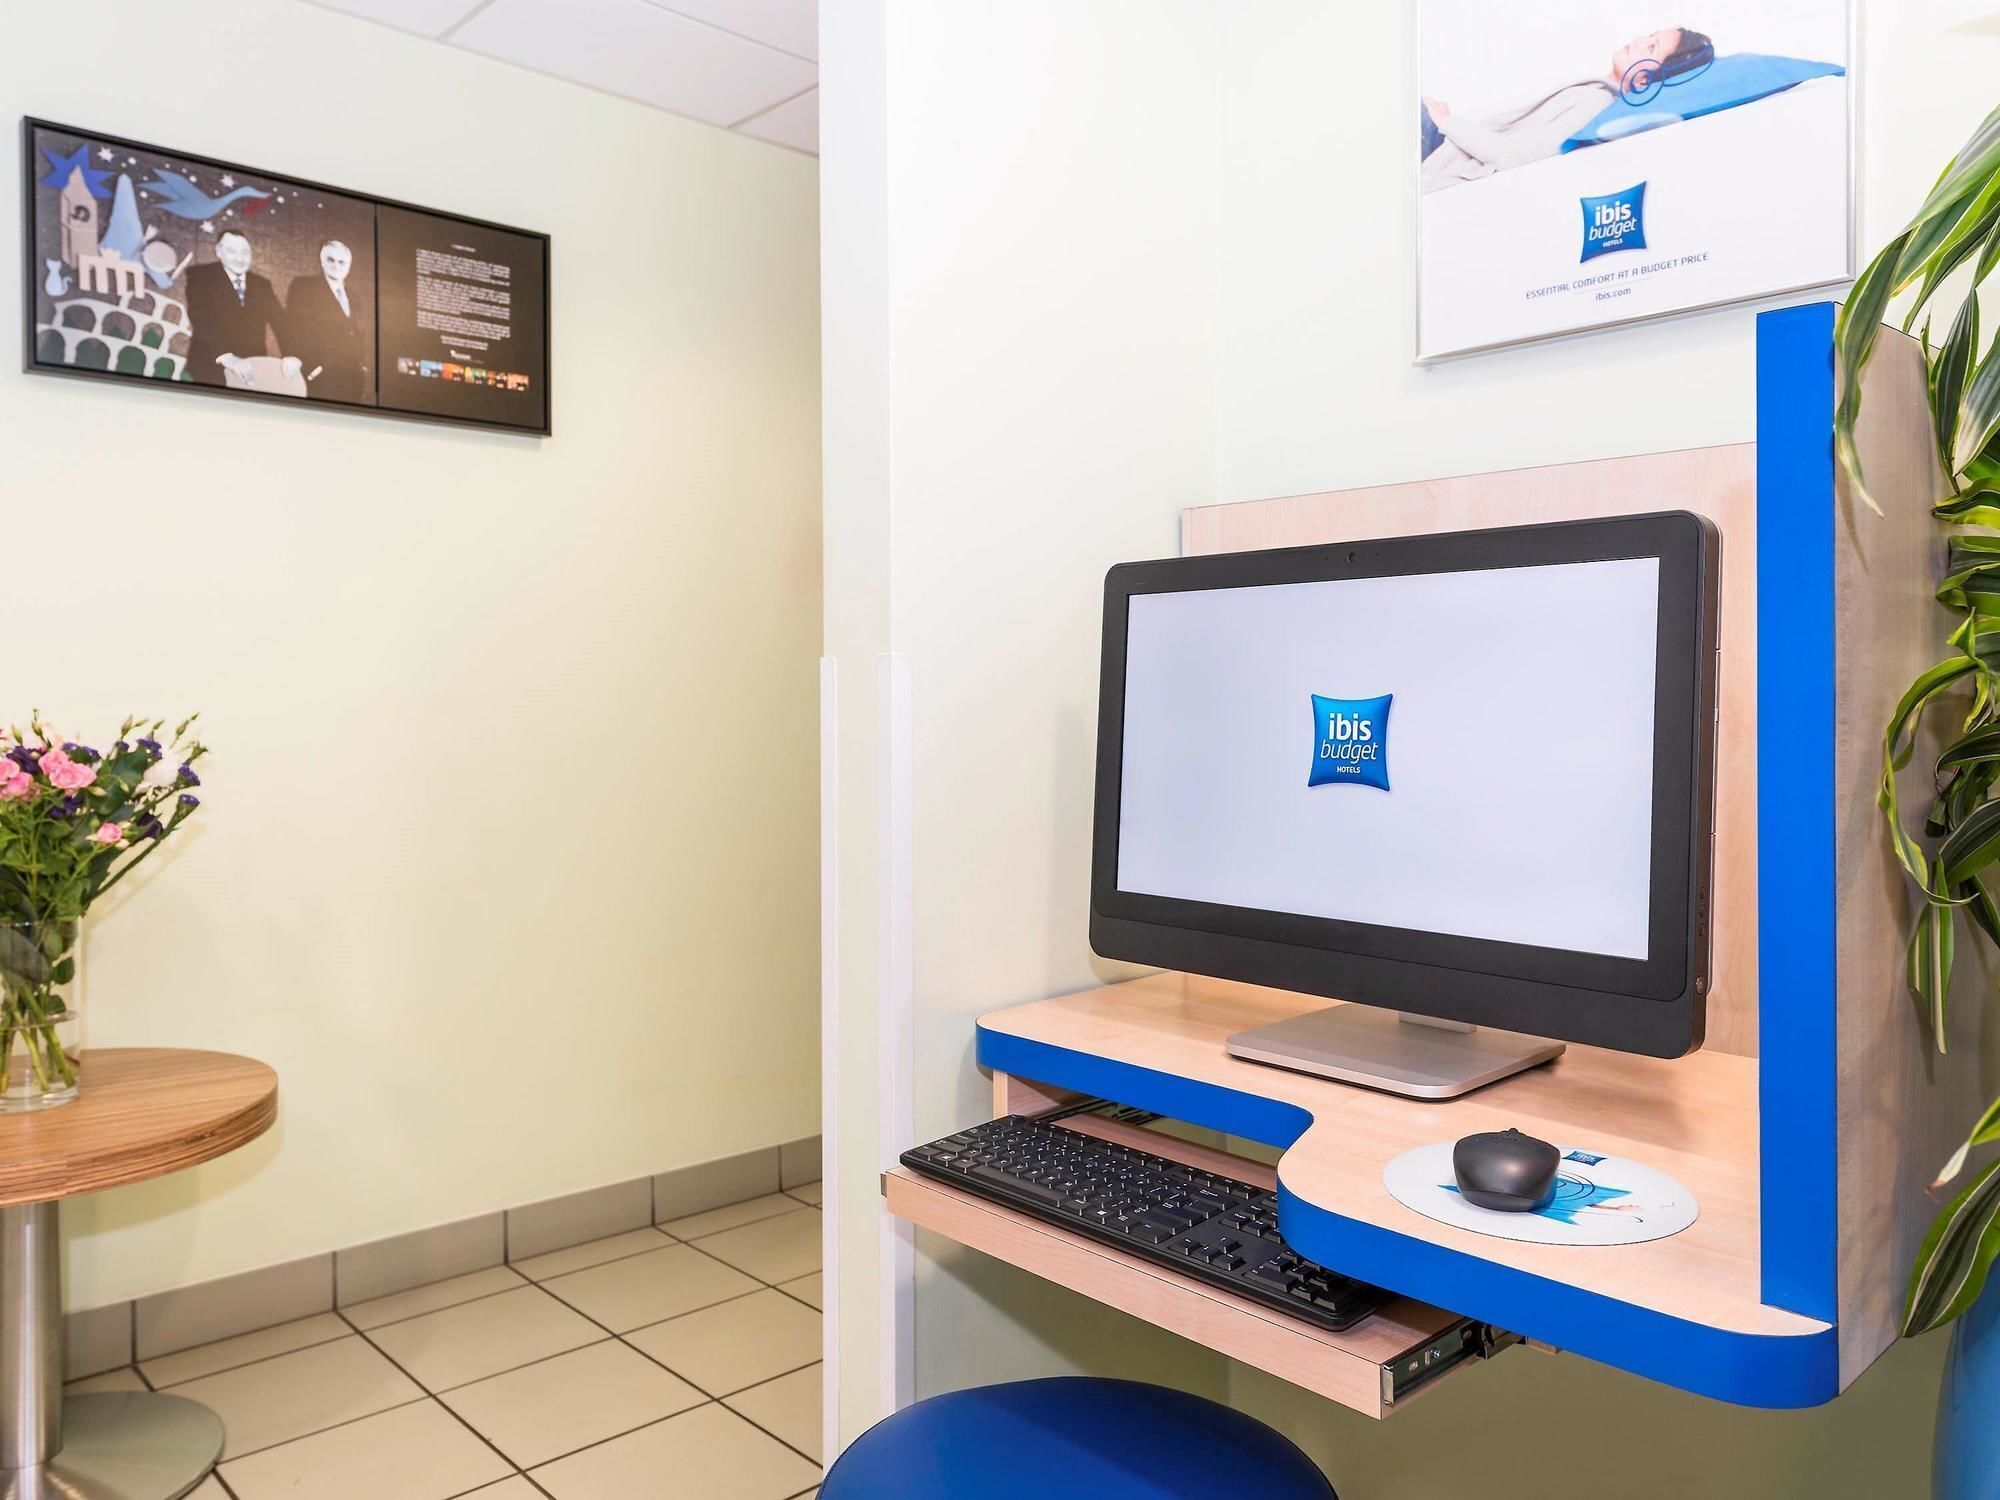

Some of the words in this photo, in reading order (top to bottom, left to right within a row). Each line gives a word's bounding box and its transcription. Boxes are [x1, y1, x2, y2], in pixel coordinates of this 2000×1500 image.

[1595, 201, 1631, 226] ibis
[1588, 216, 1638, 242] budget
[1602, 237, 1624, 248] HOTELS
[1525, 282, 1571, 300] ESSENTIAL
[1572, 272, 1615, 290] COMFORT
[1617, 269, 1629, 279] AT
[1631, 267, 1639, 277] A
[1640, 258, 1679, 275] BUDGET
[1680, 252, 1709, 266] PRICE
[1595, 287, 1631, 302] ibis.com
[1329, 713, 1372, 741] ibis
[1320, 739, 1378, 764] budget
[1336, 766, 1361, 774] HOTELS
